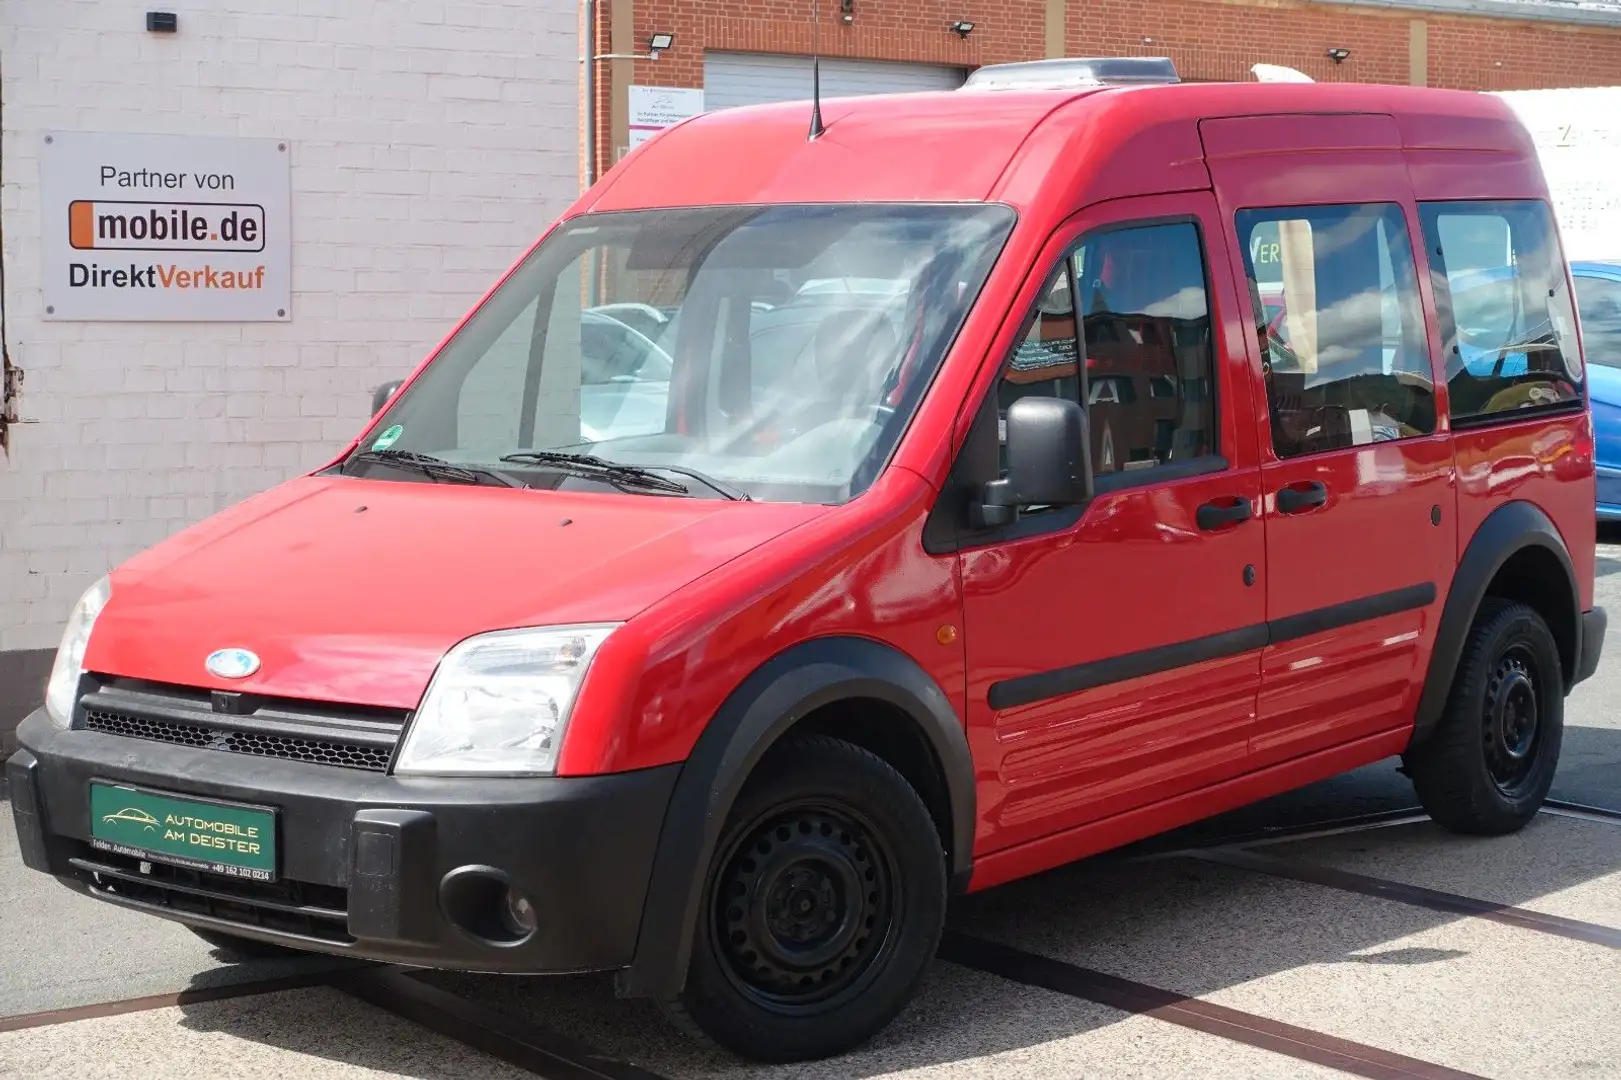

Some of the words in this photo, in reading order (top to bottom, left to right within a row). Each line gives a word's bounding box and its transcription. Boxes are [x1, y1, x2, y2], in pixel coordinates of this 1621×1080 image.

[100, 165, 187, 189] Partner
[194, 173, 235, 190] von
[98, 209, 257, 241] mobile.de
[69, 263, 265, 289] DirektVerkauf
[165, 814, 259, 839] AUTOMOBILE
[164, 829, 185, 842] AM
[190, 833, 260, 855] DEISTER
[113, 844, 146, 858] Automobile
[212, 864, 224, 873] +49
[225, 866, 237, 875] 162
[239, 868, 251, 877] 102
